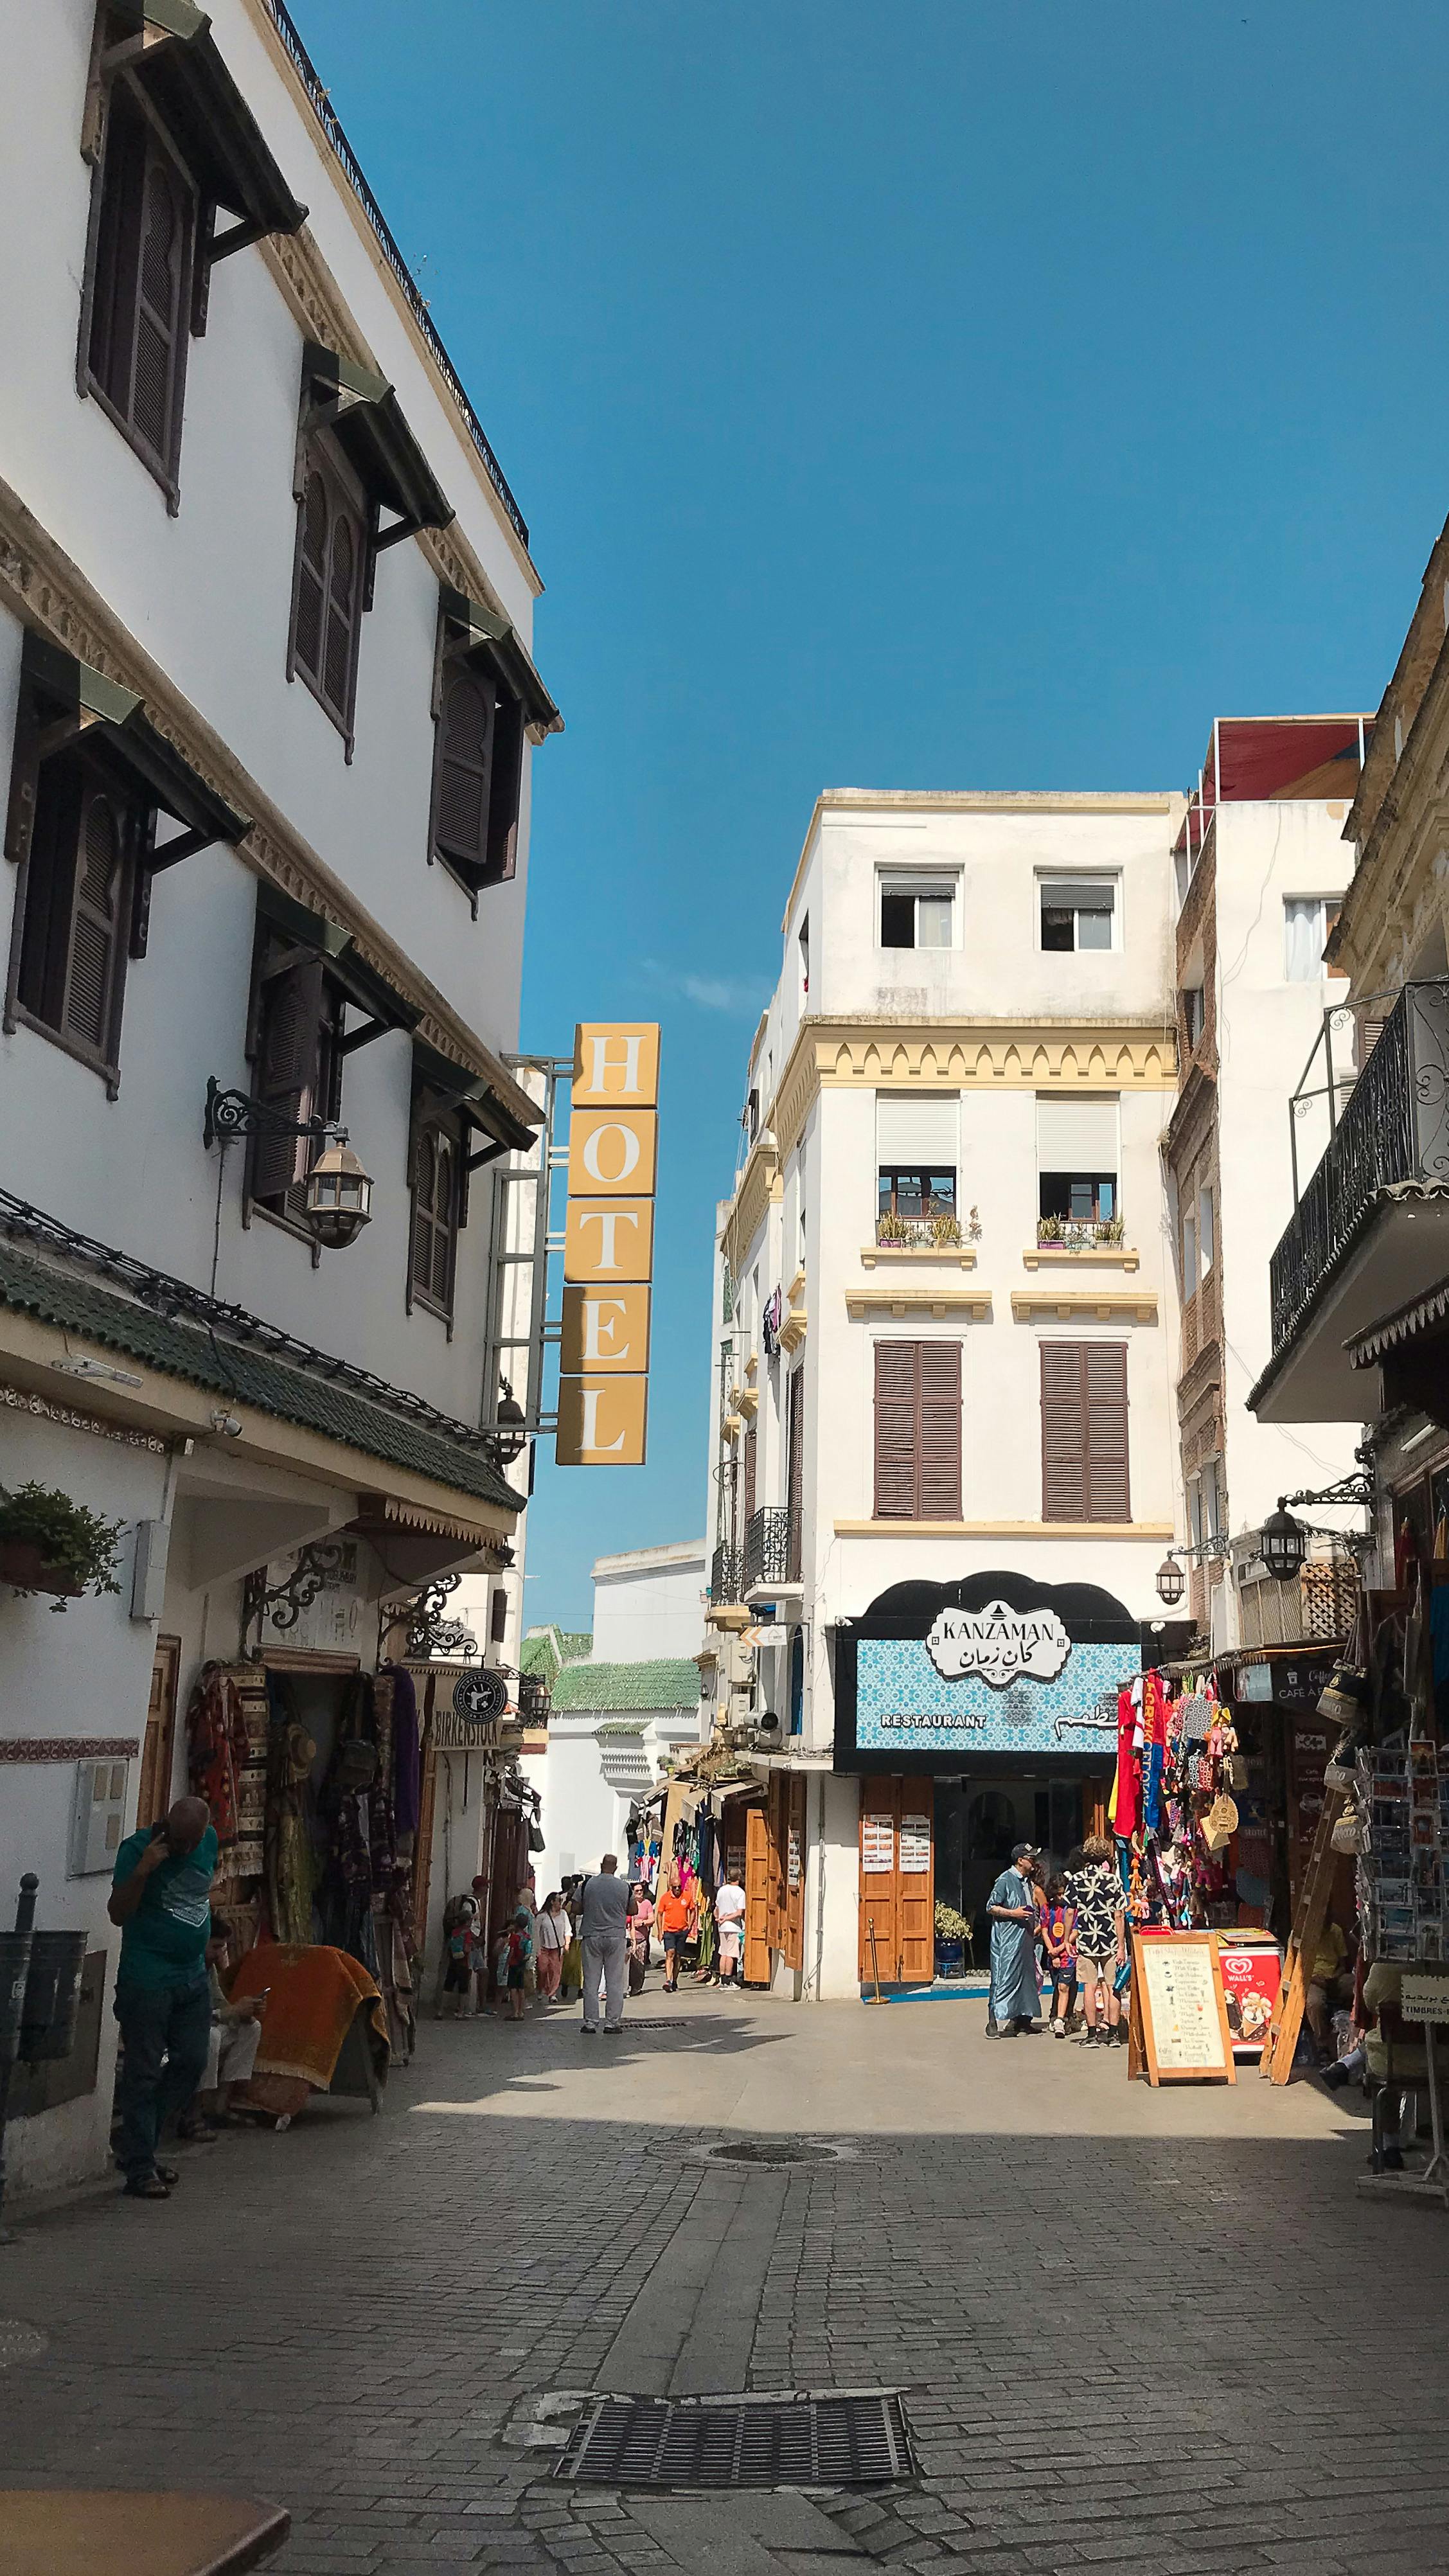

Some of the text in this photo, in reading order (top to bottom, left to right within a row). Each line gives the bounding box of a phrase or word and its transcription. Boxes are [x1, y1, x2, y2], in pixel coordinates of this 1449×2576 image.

[574, 1035, 646, 1450] HOTEL
[943, 1622, 1054, 1640] KANZAMAN
[959, 1640, 1038, 1668] كان زمان
[1279, 1687, 1305, 1699] CAFÉ
[881, 1714, 987, 1729] RESTAURANT
[1054, 1704, 1119, 1741] طعم
